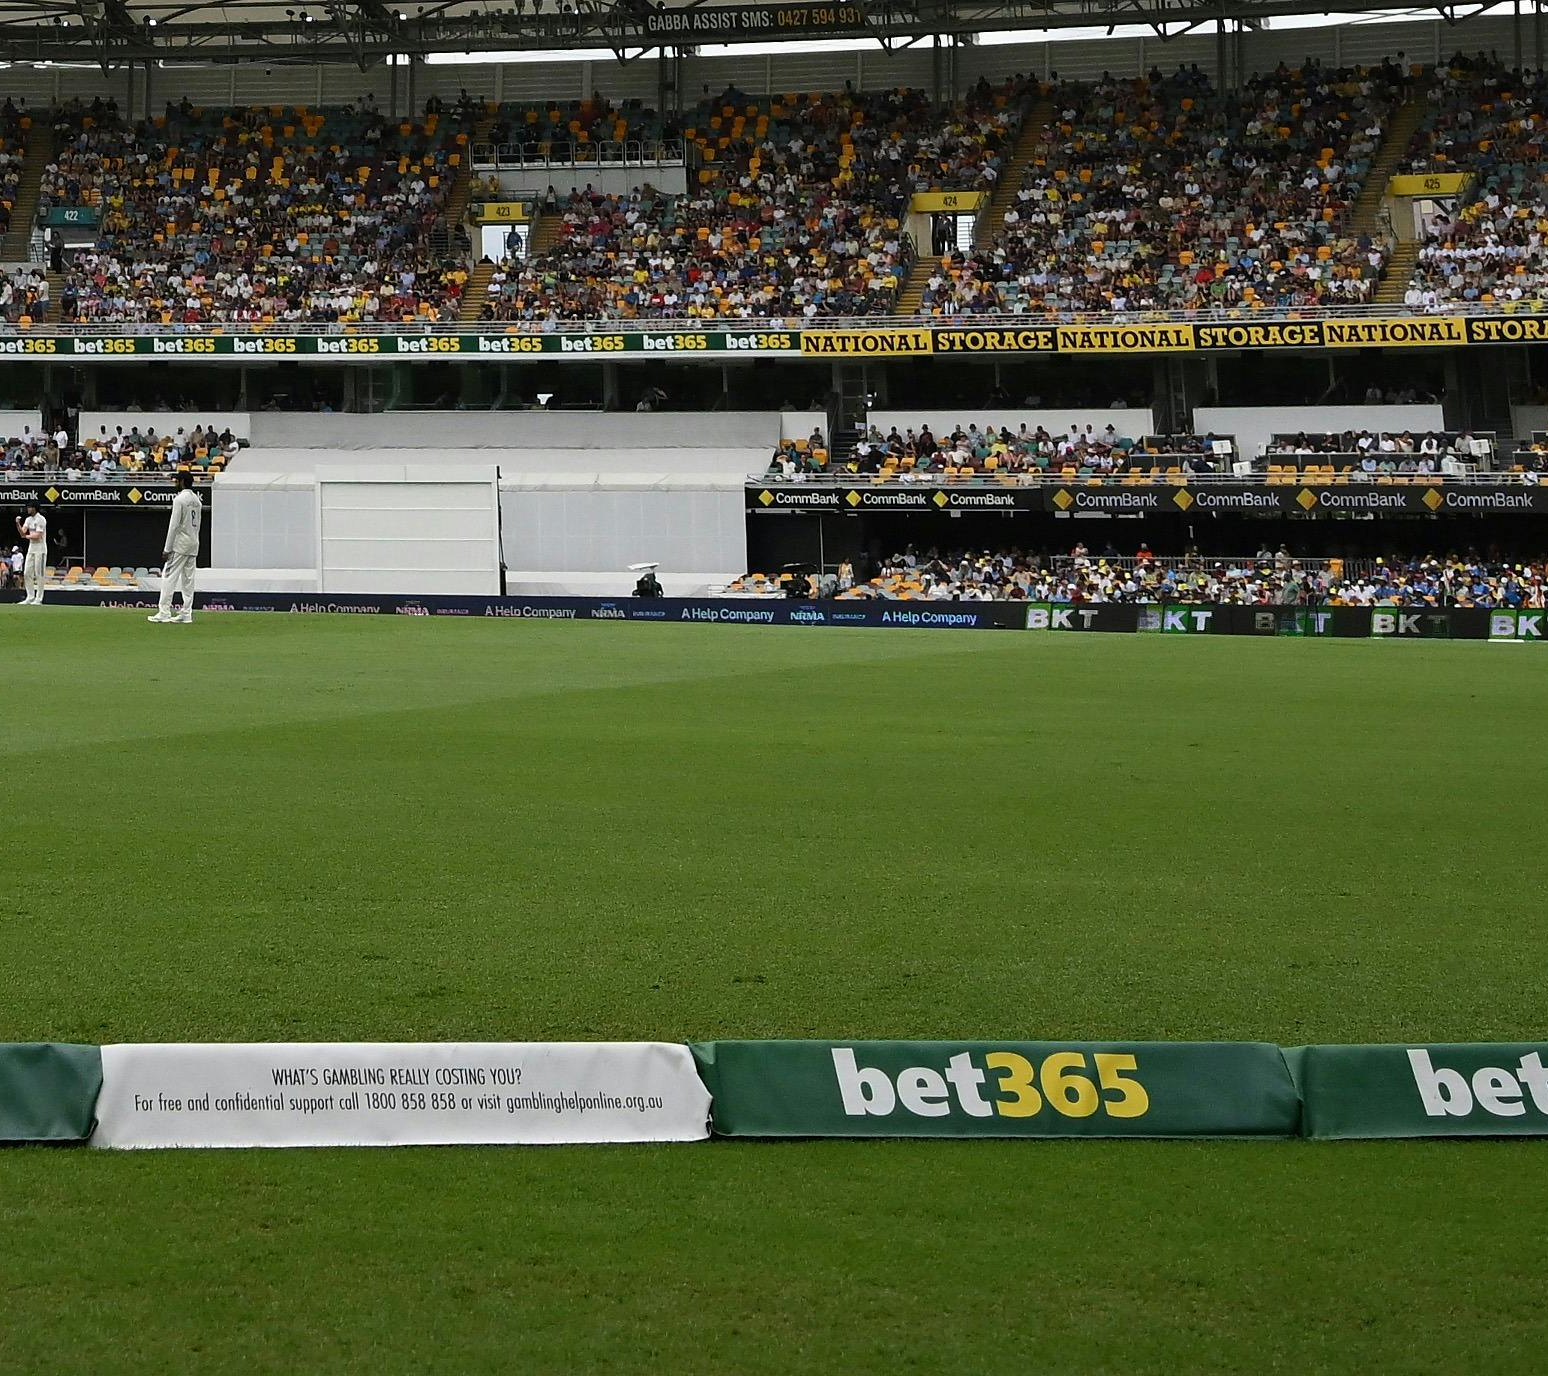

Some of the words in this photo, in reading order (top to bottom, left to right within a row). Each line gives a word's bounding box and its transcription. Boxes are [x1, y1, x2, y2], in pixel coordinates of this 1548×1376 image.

[1424, 179, 1440, 190] 425
[943, 196, 957, 207] 424
[64, 210, 78, 220] 422
[496, 206, 510, 216] 423
[1326, 323, 1462, 342] NATIONAL
[74, 338, 135, 353] bet365
[318, 339, 378, 353] bet365
[726, 333, 790, 350] bet365
[804, 333, 928, 352] NATIONAL
[938, 332, 1053, 351] STORAGE
[61, 489, 120, 502] CommBank
[863, 493, 926, 505] CommBank
[1076, 493, 1157, 507] CommBank
[1447, 492, 1533, 508] CommBank
[883, 612, 894, 623] A
[894, 612, 920, 624] Help
[922, 613, 977, 626] Company
[1028, 609, 1098, 629] BKT
[272, 1068, 318, 1085] WHAT'S
[323, 1068, 384, 1085] GAMBLING
[390, 1068, 429, 1085] REALLY
[436, 1068, 485, 1085] COSTING
[490, 1068, 522, 1085] YOU?
[830, 1048, 1151, 1118] bet365
[135, 1094, 153, 1111] For
[158, 1093, 182, 1111] free
[188, 1094, 209, 1111] and
[215, 1092, 284, 1112] confidential
[290, 1094, 334, 1114] support
[339, 1092, 359, 1110] call
[364, 1093, 396, 1109] 1800
[402, 1093, 426, 1109] 858
[432, 1093, 456, 1109] 858
[462, 1098, 473, 1109] or
[477, 1094, 501, 1109] visit
[506, 1091, 662, 1114] gamblinghelponline.org.au
